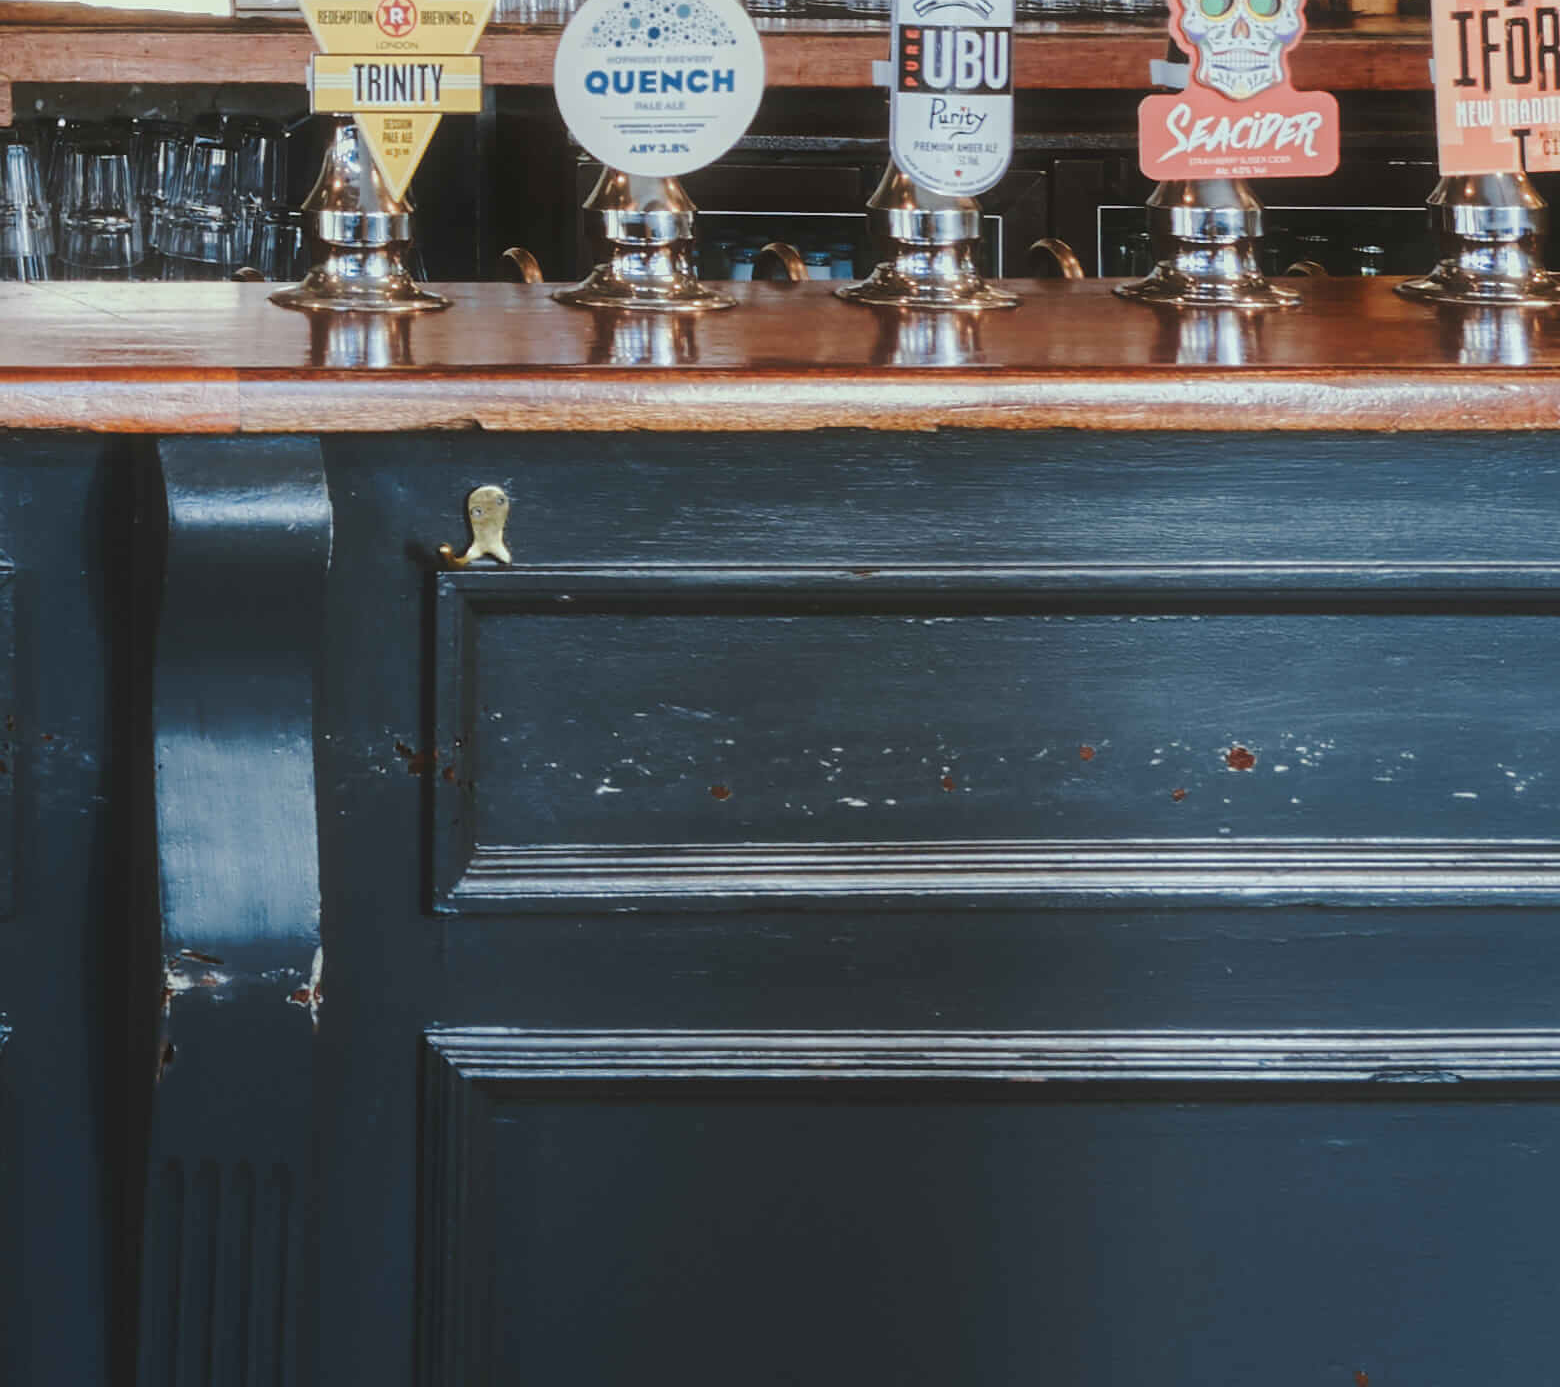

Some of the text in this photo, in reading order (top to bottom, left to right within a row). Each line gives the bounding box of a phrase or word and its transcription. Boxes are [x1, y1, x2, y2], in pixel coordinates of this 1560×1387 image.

[375, 40, 419, 51] LONDON
[903, 26, 921, 88] PURE
[922, 29, 1010, 92] UBU
[352, 63, 445, 106] TRINITY
[583, 68, 736, 97] QUENCH
[928, 96, 989, 135] Purity
[1156, 102, 1323, 163] SEACIDER
